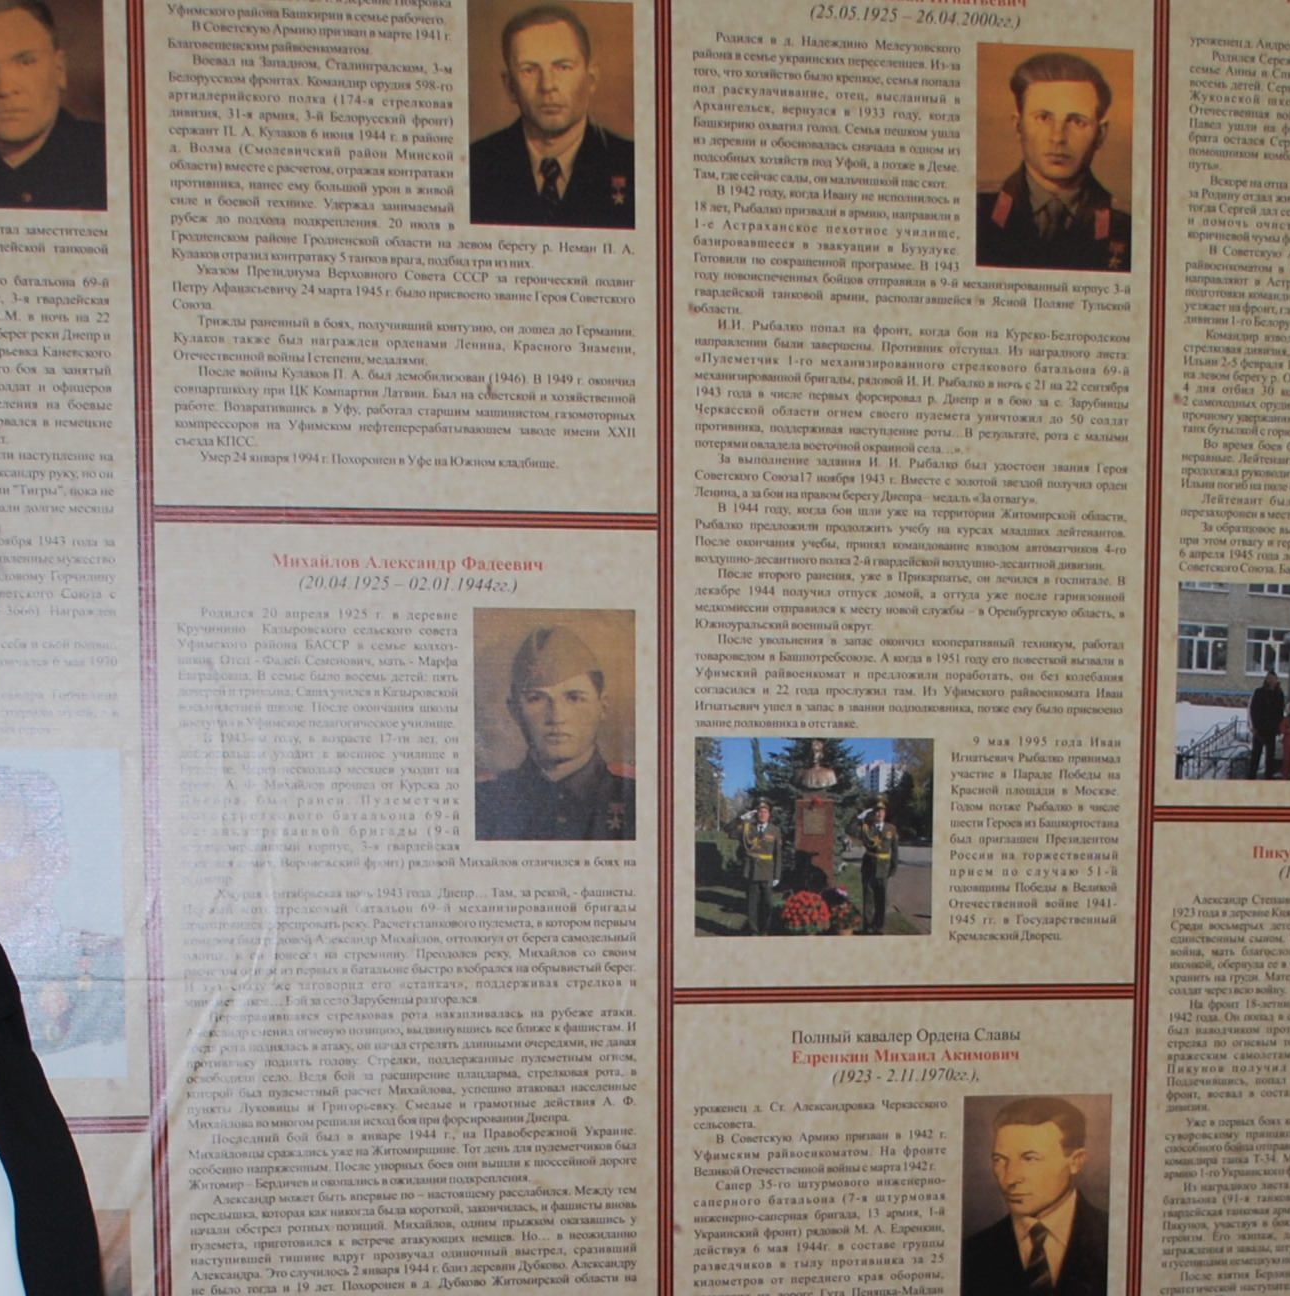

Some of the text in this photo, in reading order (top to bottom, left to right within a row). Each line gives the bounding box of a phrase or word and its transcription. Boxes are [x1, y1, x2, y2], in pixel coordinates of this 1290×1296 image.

[810, 4, 898, 22] (25.05.1925
[916, 10, 1021, 28] 26.04.2000гг.)
[433, 63, 452, 74] 3-м
[273, 554, 543, 572] Михайлов Александр Фадеевич
[299, 575, 389, 590] (20.04.1925
[409, 577, 517, 591] 02.01.1944гг.)
[973, 736, 980, 745] 9
[1019, 737, 1047, 746] 1995
[1090, 737, 1121, 747] Иван
[950, 866, 1118, 879] прием по случаю 51-й
[792, 1028, 1020, 1046] Полный кавалер Ордена Славы
[792, 1048, 1019, 1067] Едренкин Михаил Акимович
[832, 1070, 872, 1085] (1923
[887, 1068, 979, 1082] 2.11.1970гг.),
[716, 1178, 945, 1193] Сапер 35-го штурмового инженерно-
